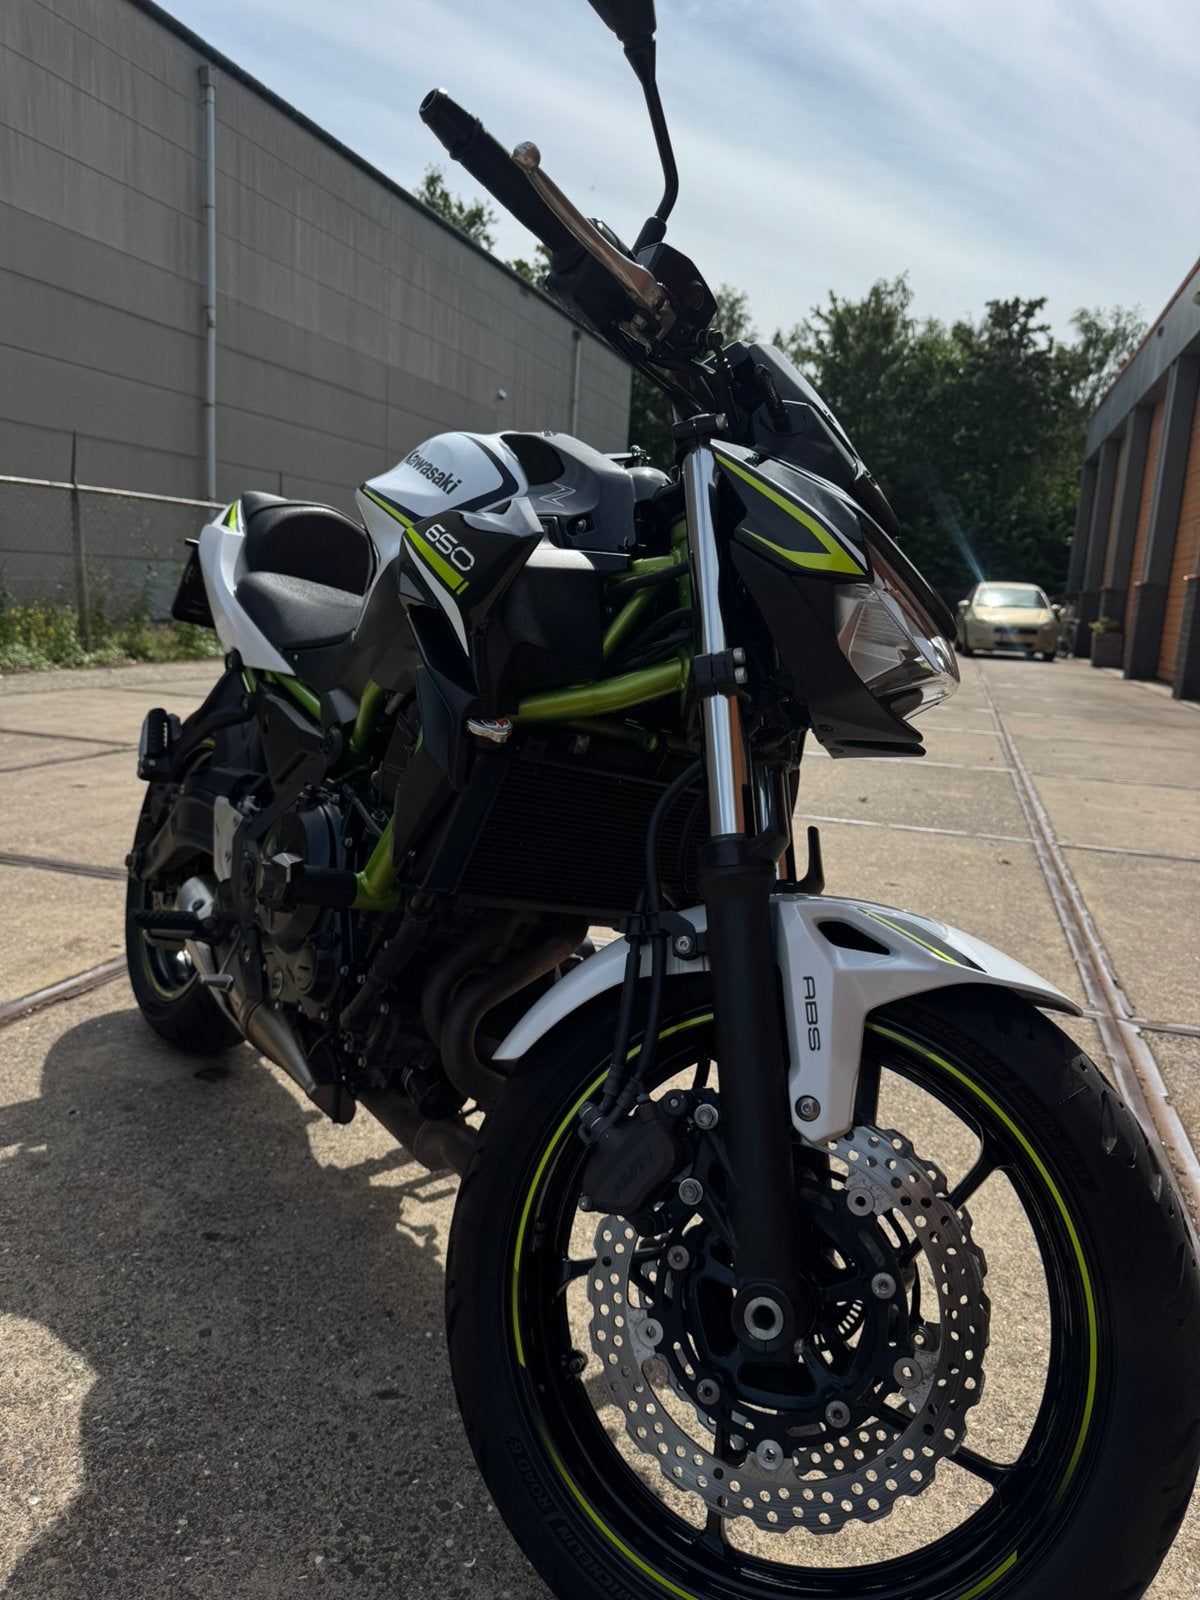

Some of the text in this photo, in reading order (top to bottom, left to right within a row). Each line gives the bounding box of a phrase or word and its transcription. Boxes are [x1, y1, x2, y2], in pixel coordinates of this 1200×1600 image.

[405, 450, 462, 495] Kawasaki
[425, 523, 475, 572] 650
[803, 976, 821, 1051] ABS
[518, 1458, 552, 1509] ROAD
[555, 1524, 639, 1600] MICHELIN
